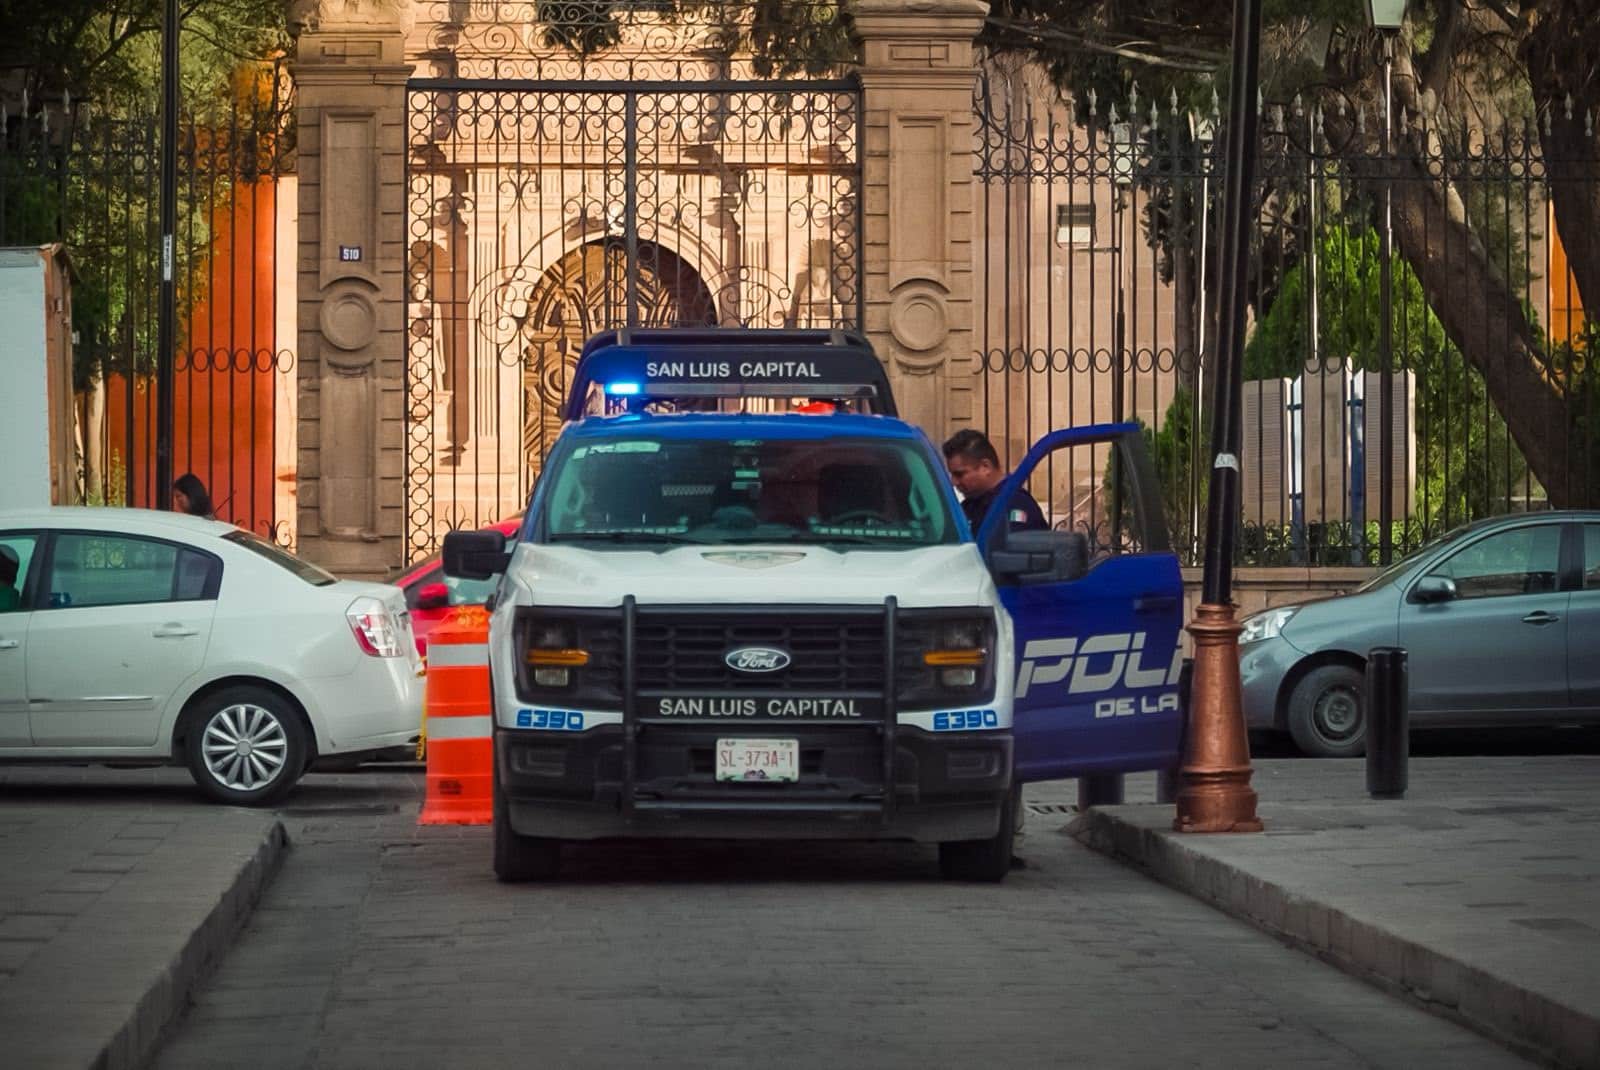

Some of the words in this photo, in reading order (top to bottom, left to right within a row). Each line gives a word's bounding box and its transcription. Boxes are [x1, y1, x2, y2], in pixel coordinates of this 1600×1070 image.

[343, 248, 360, 260] 510
[646, 362, 684, 377] SAN
[689, 362, 730, 377] LUIS
[739, 362, 821, 377] CAPITAL
[737, 651, 778, 668] Ford
[659, 699, 703, 716] SAN
[709, 699, 757, 716] LUIS
[767, 699, 862, 716] CAPITAL
[1095, 697, 1136, 718] DE
[1141, 693, 1179, 713] LA
[517, 709, 584, 730] 6390
[934, 710, 998, 730] 6390
[719, 749, 794, 768] SL-373A-1
